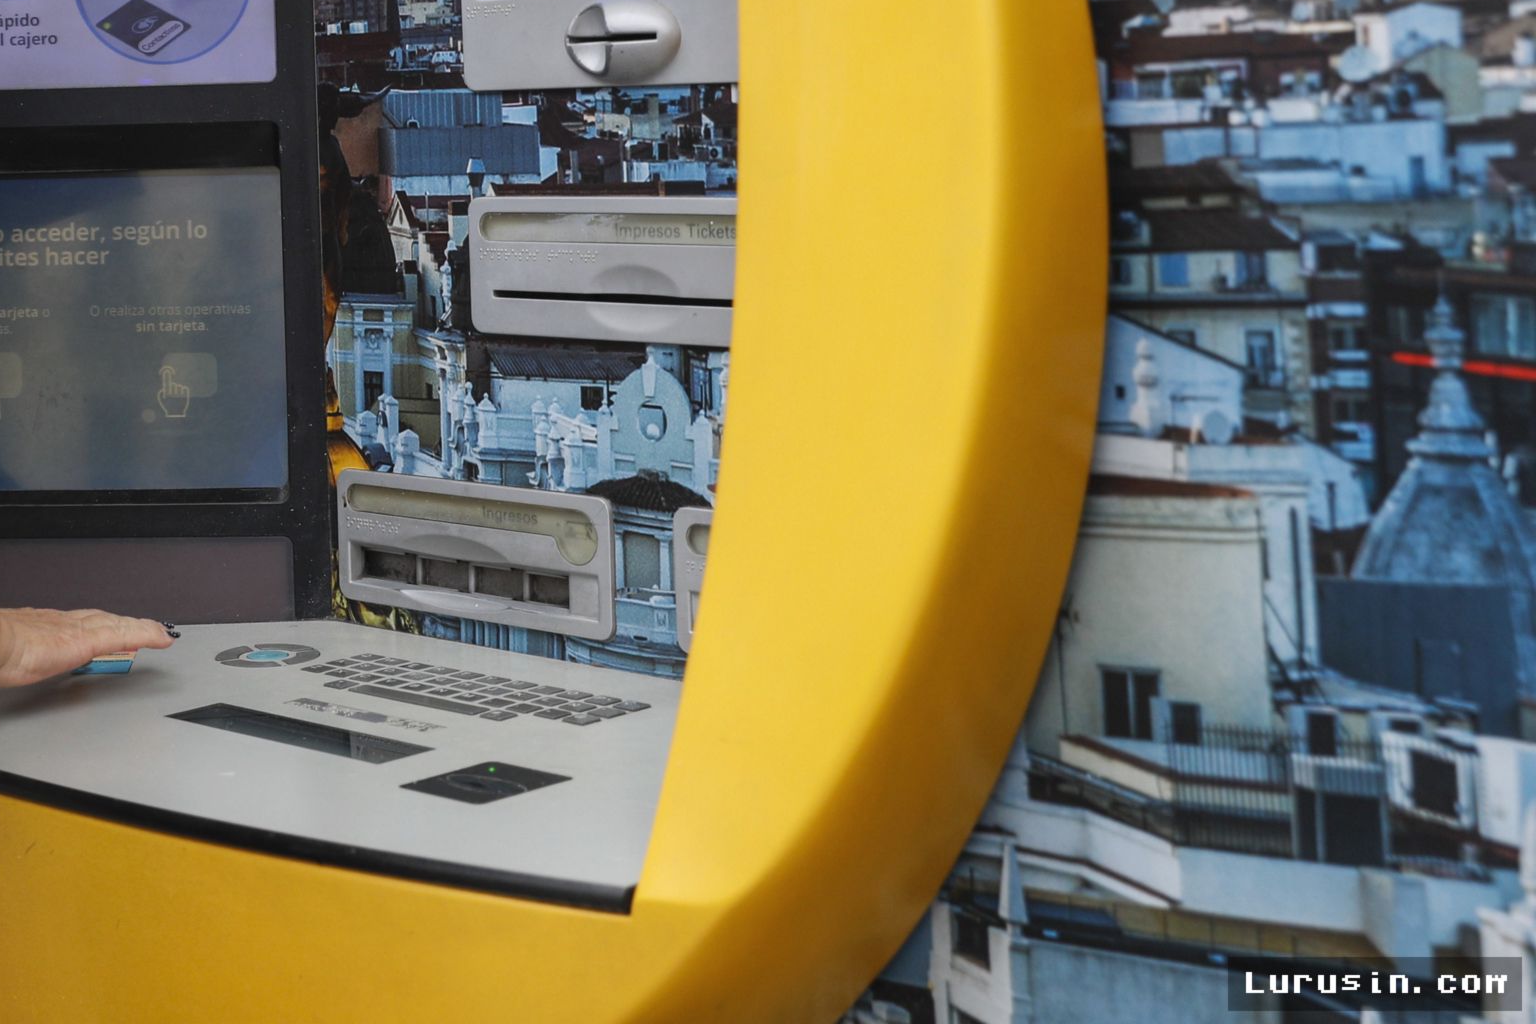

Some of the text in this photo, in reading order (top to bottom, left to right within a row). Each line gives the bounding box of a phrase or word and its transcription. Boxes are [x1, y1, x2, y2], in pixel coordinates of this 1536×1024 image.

[9, 31, 58, 49] cajero
[11, 222, 106, 244] acceder,
[113, 221, 180, 246] según
[187, 220, 208, 240] lo
[614, 222, 736, 240] Impresos Tickets
[46, 246, 109, 267] hacer
[104, 304, 145, 317] realiza
[184, 303, 251, 318] operativas
[136, 319, 208, 334] sin tarjeta.
[482, 505, 538, 526] Ingresos
